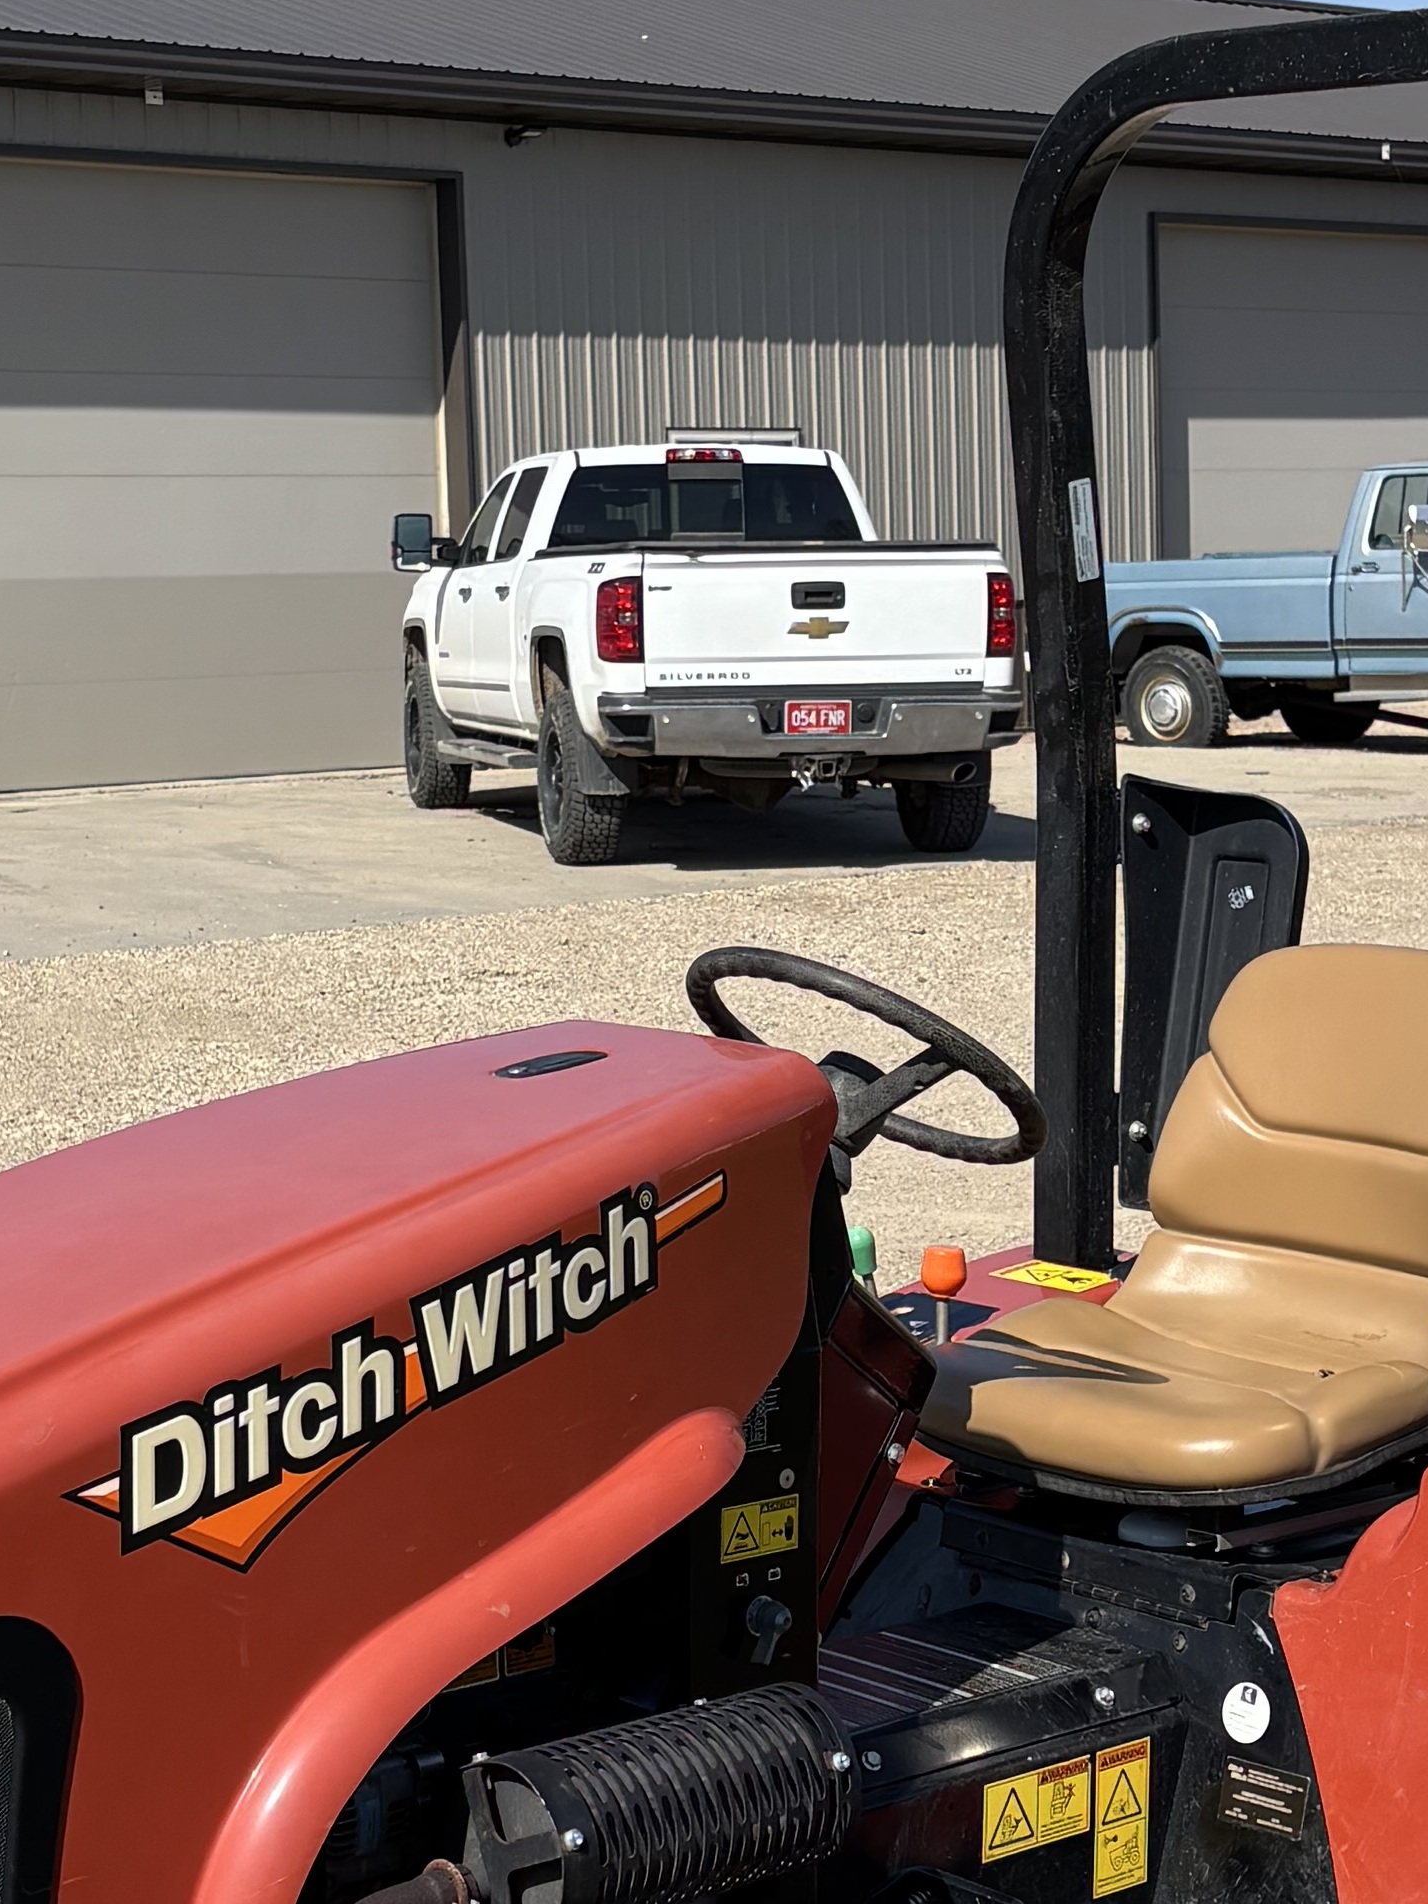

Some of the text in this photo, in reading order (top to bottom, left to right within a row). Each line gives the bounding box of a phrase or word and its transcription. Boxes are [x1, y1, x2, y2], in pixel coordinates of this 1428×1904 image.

[659, 672, 751, 681] SILVERADO
[792, 709, 845, 726] 054 FNR
[131, 1335, 395, 1536] Ditch
